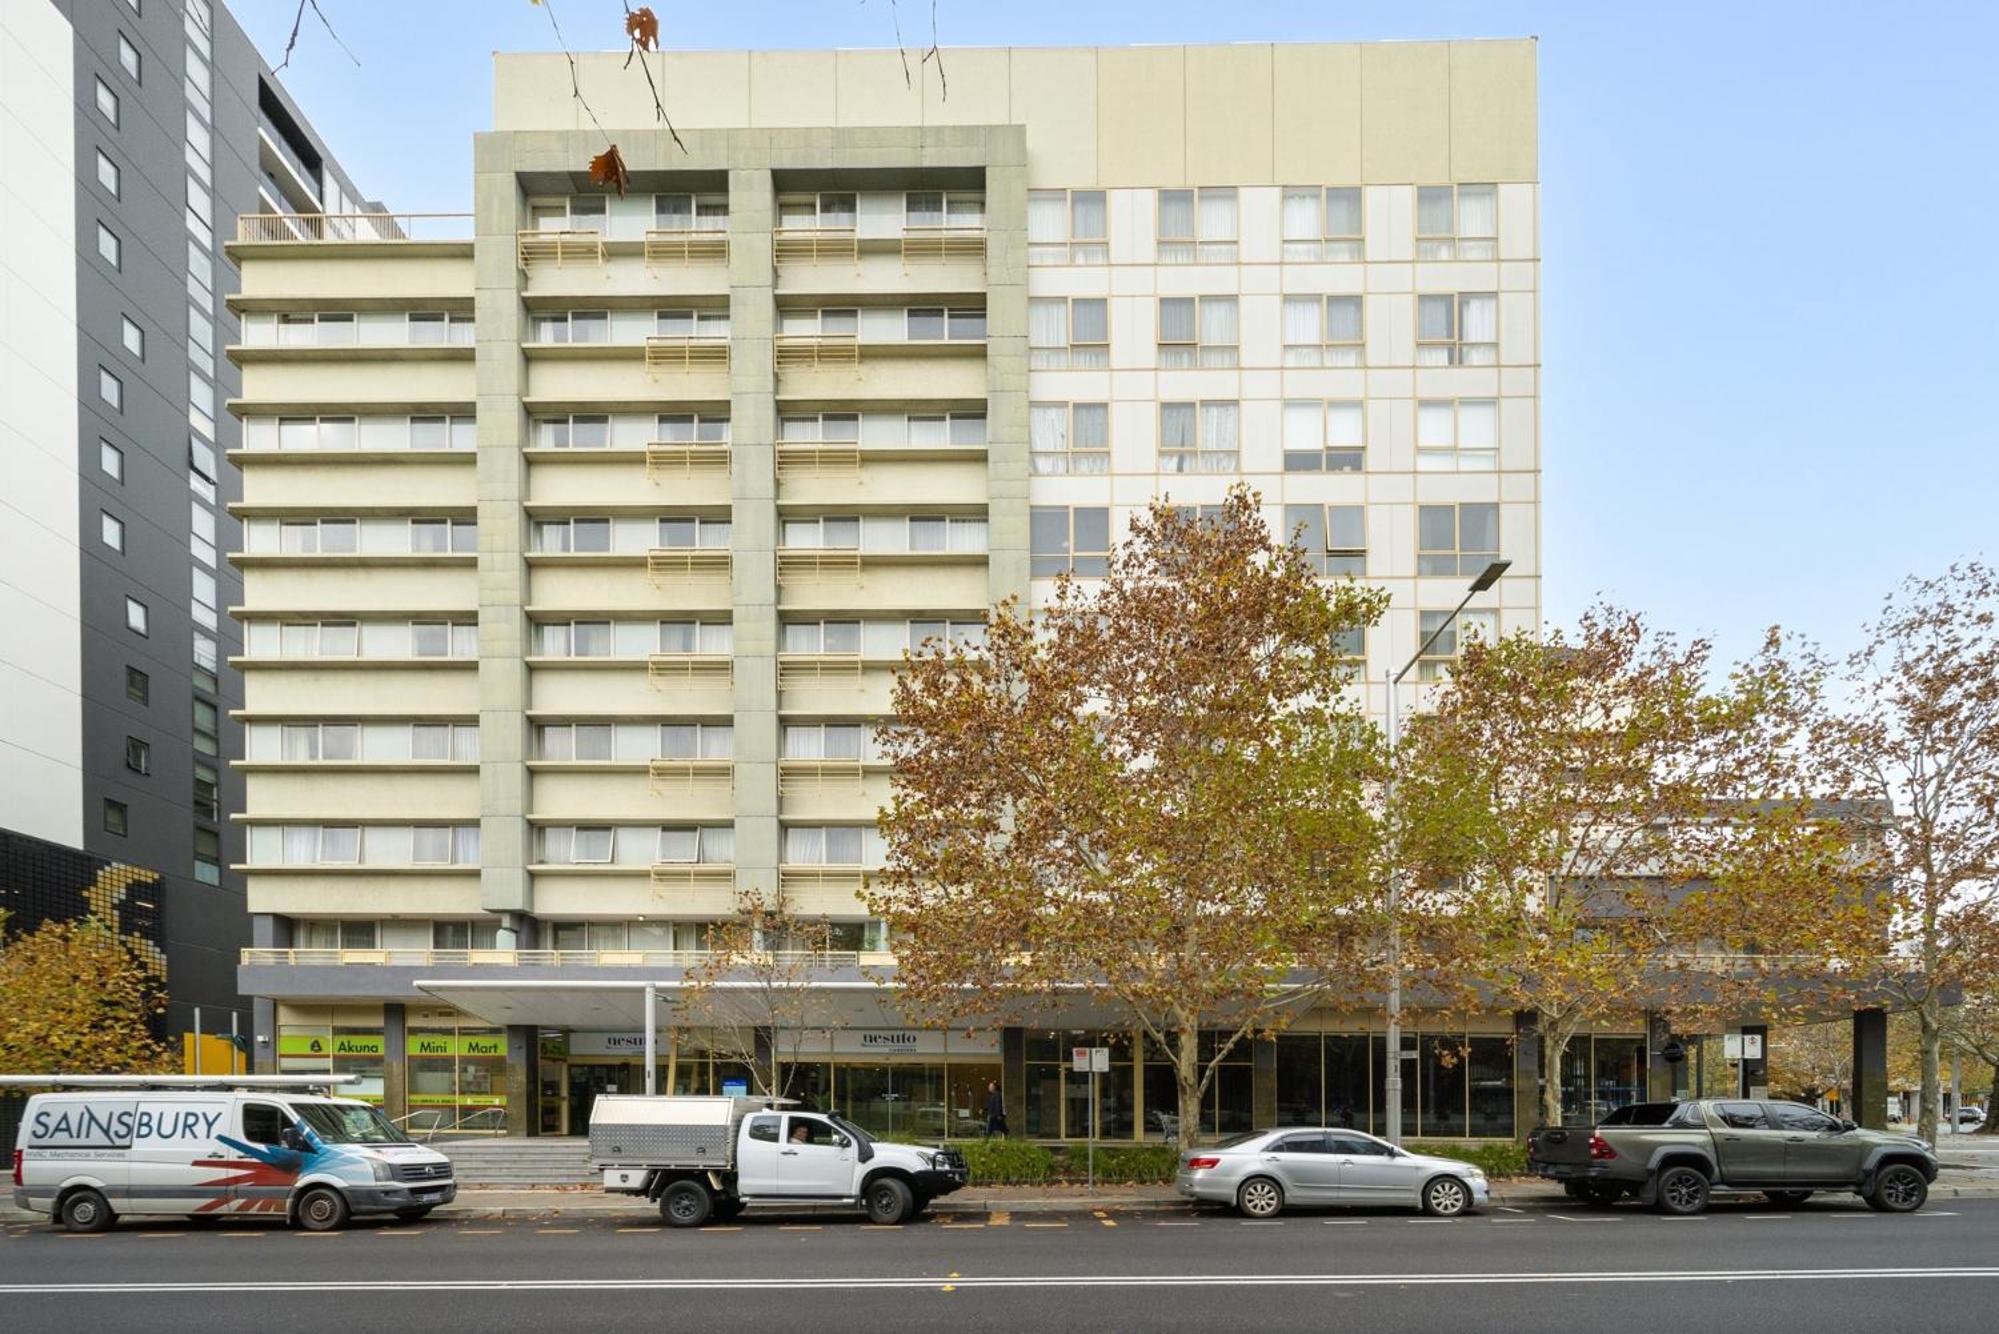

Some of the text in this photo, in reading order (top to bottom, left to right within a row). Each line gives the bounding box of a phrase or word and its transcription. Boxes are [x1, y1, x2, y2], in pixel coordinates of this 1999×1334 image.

[863, 1032, 917, 1044] nesuto
[337, 1040, 498, 1053] Akuna Mini Mart
[31, 1105, 223, 1145] SAINSBURY
